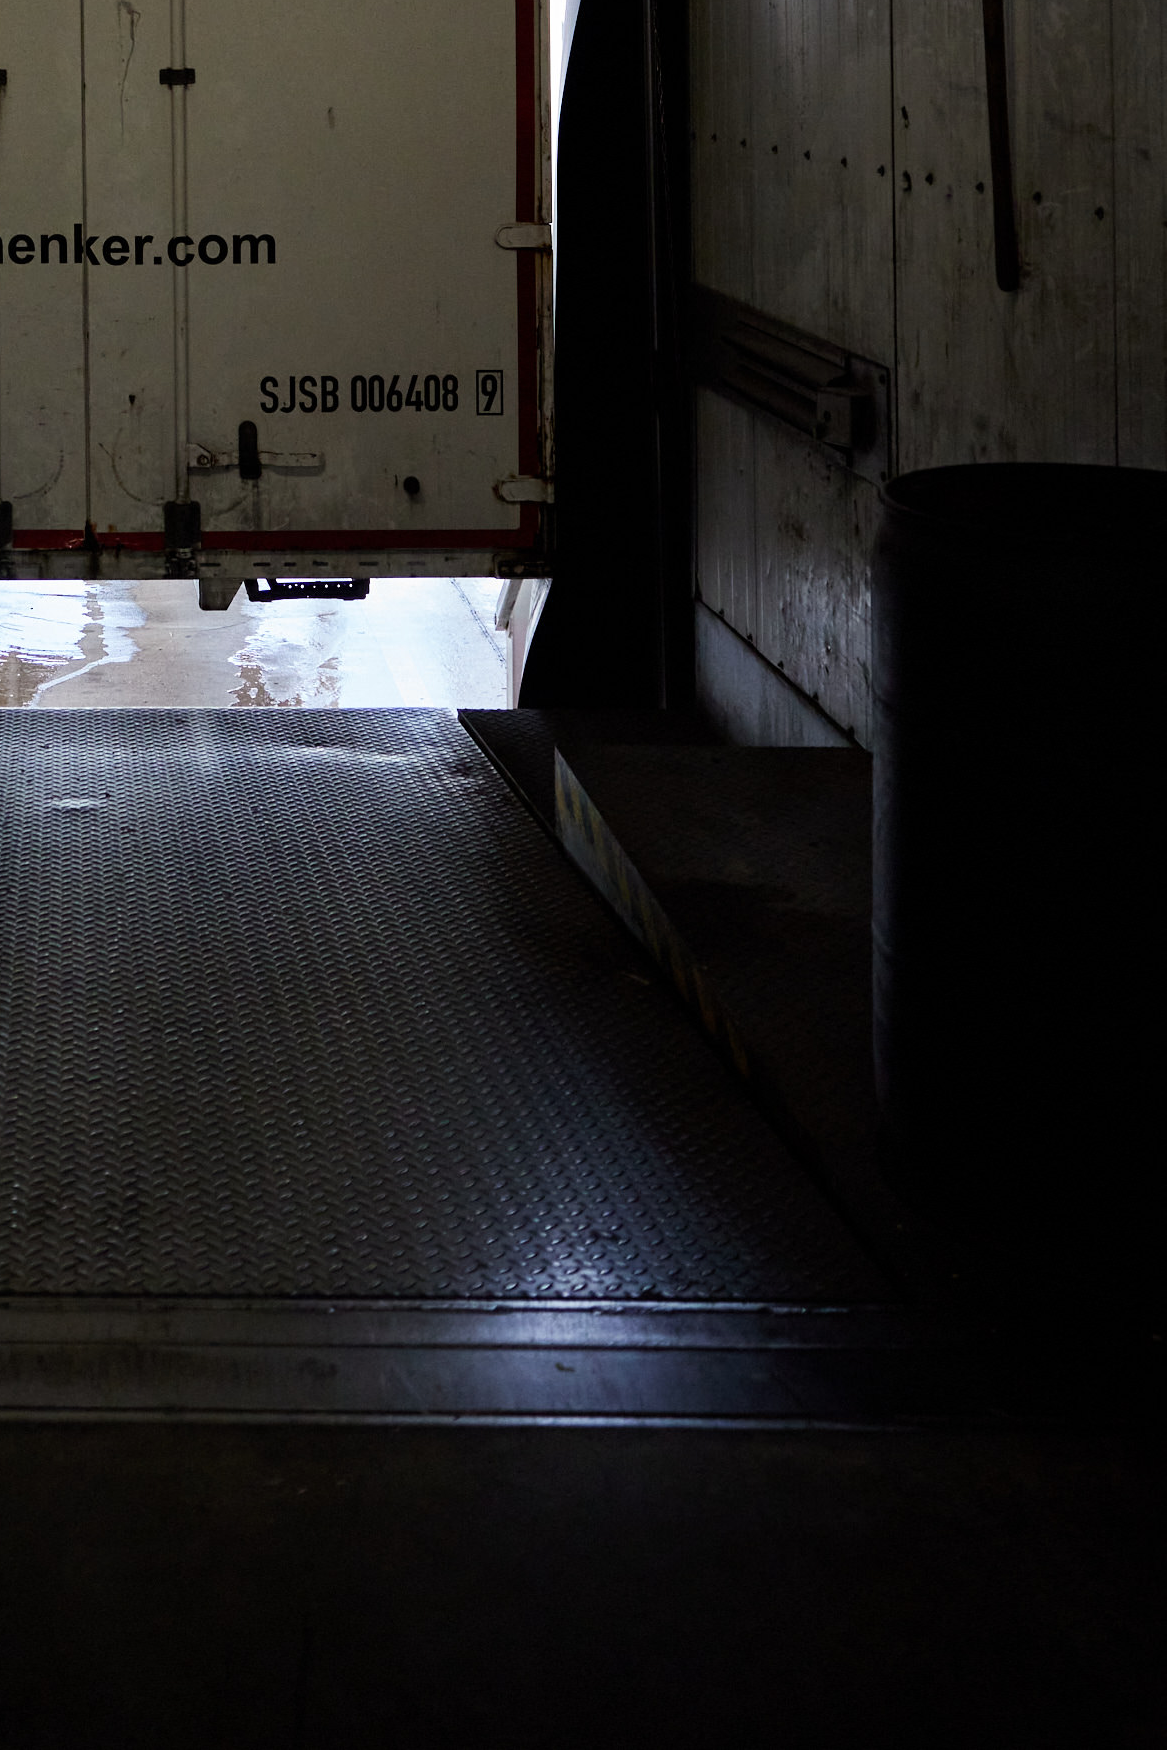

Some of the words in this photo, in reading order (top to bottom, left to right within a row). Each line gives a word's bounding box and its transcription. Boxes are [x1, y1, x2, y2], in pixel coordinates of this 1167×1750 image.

[260, 375, 339, 414] SJSB
[350, 374, 459, 413] 006408
[480, 372, 500, 413] 9
